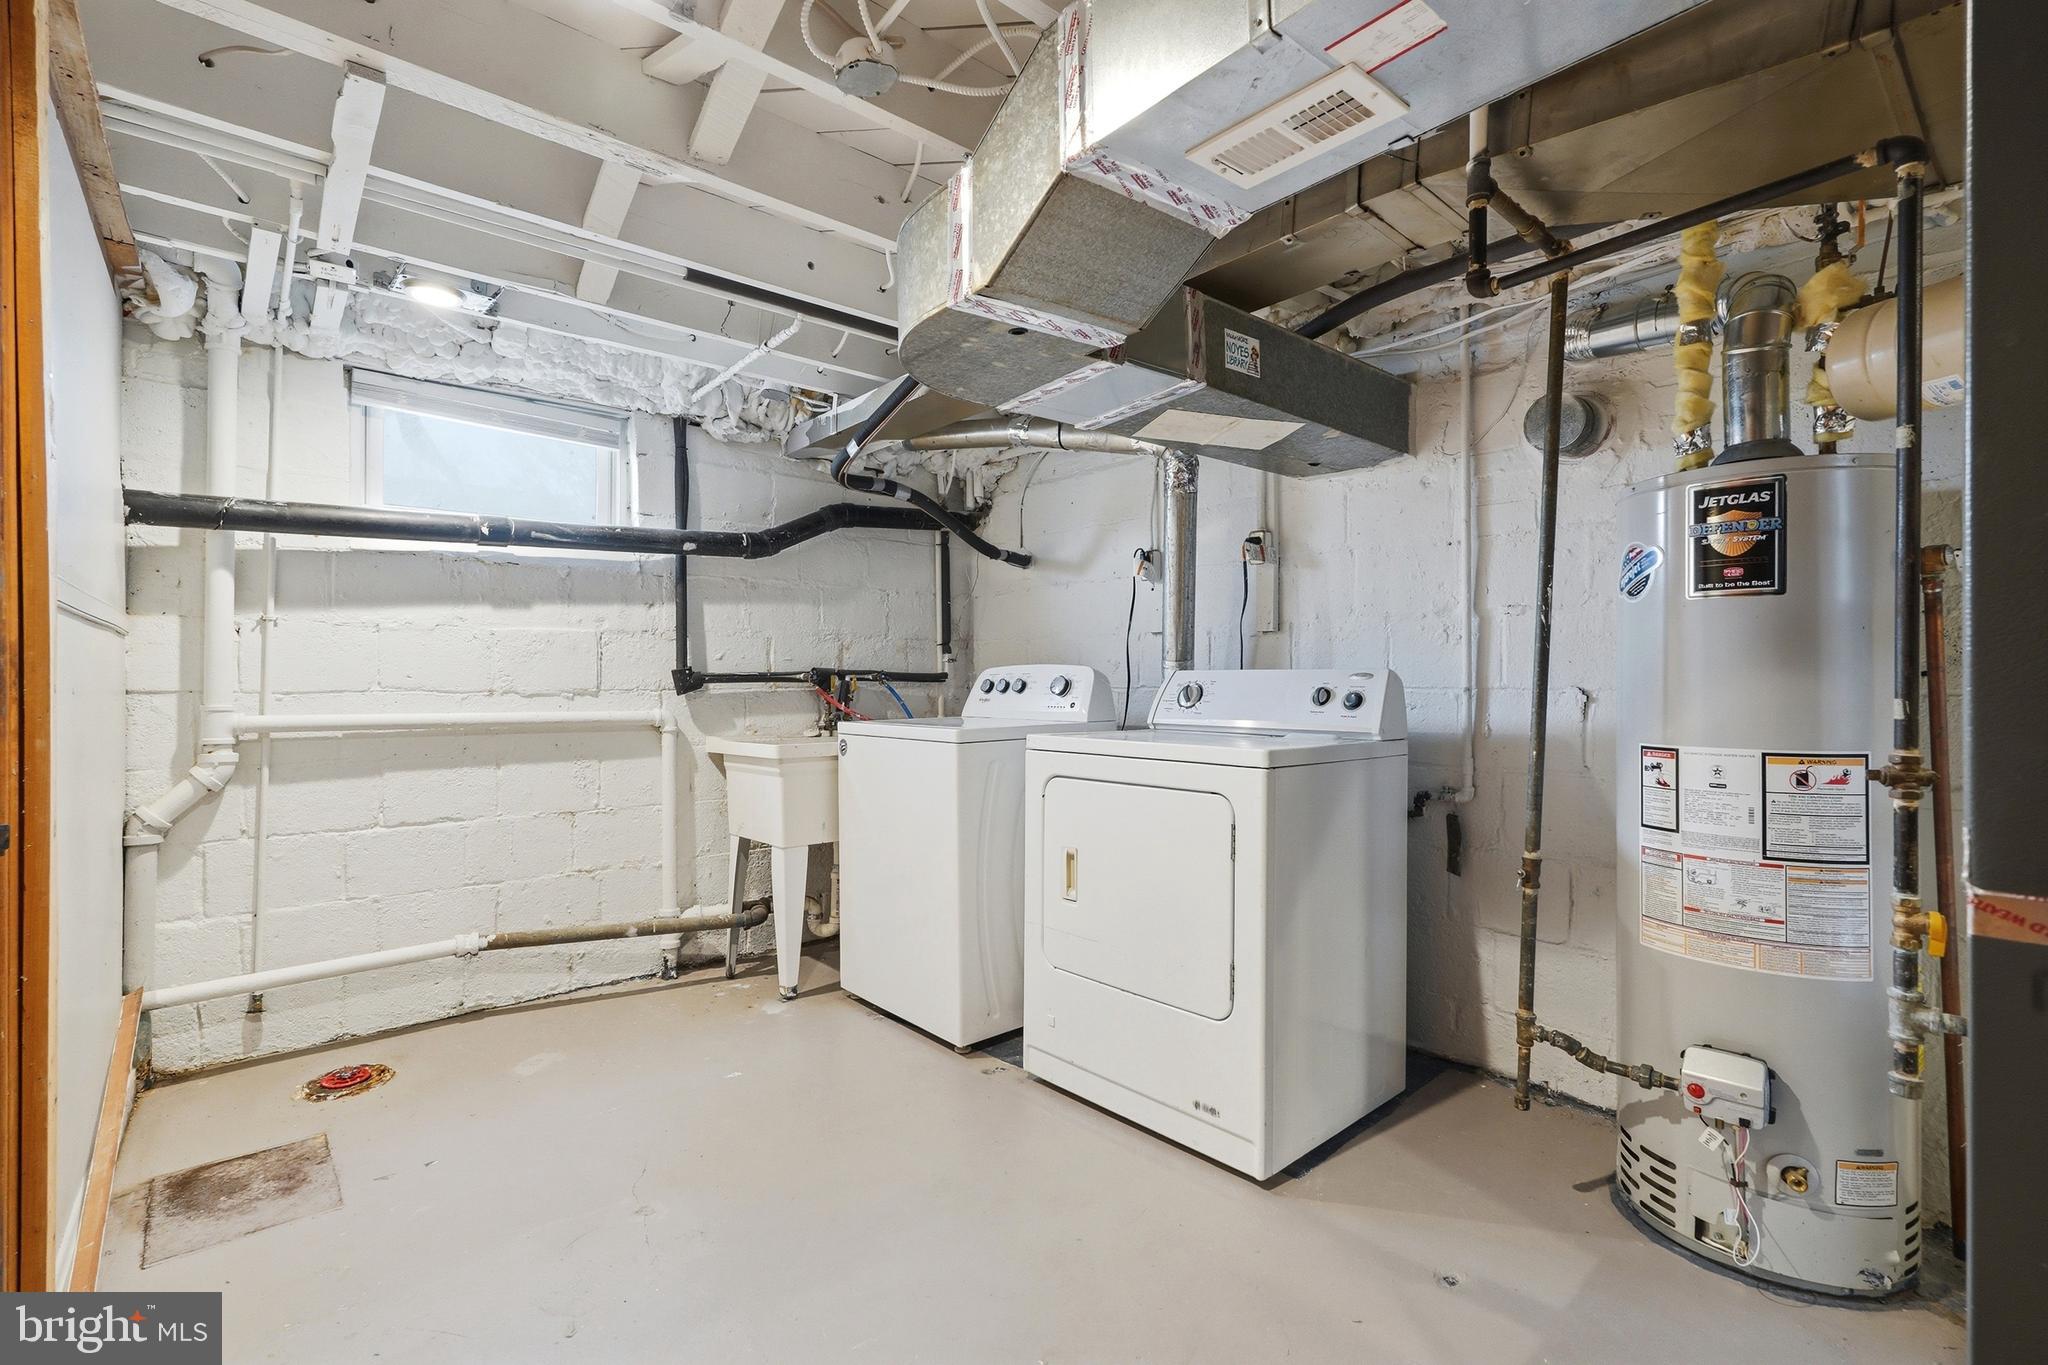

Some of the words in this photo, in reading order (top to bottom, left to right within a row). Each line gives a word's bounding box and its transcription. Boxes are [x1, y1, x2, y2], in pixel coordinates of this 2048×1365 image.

[1226, 341, 1249, 358] NOYES
[1699, 491, 1771, 509] JETGLAS
[1689, 518, 1783, 537] DEFENDER
